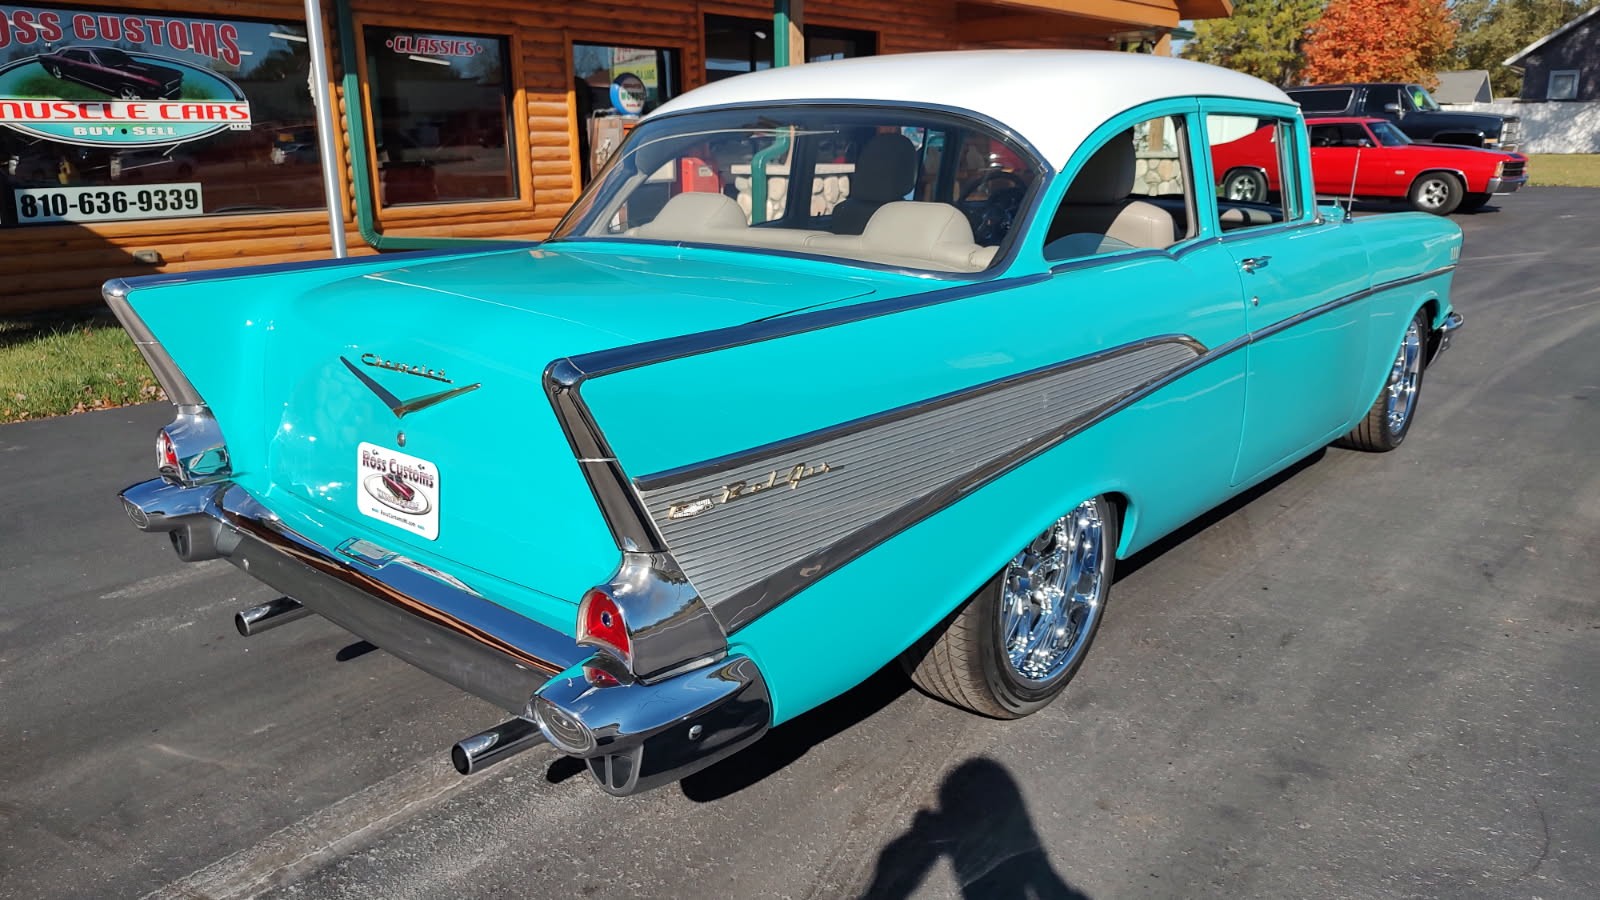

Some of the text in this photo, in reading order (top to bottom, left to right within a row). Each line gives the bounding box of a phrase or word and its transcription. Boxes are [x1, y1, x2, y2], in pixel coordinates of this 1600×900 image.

[73, 14, 241, 66] CUSTOMS
[394, 35, 476, 57] CLASSICS
[160, 104, 248, 120] CARS
[73, 126, 176, 136] BUY SELL
[20, 188, 199, 218] 810-636-9339
[362, 449, 435, 489] Ross Customs
